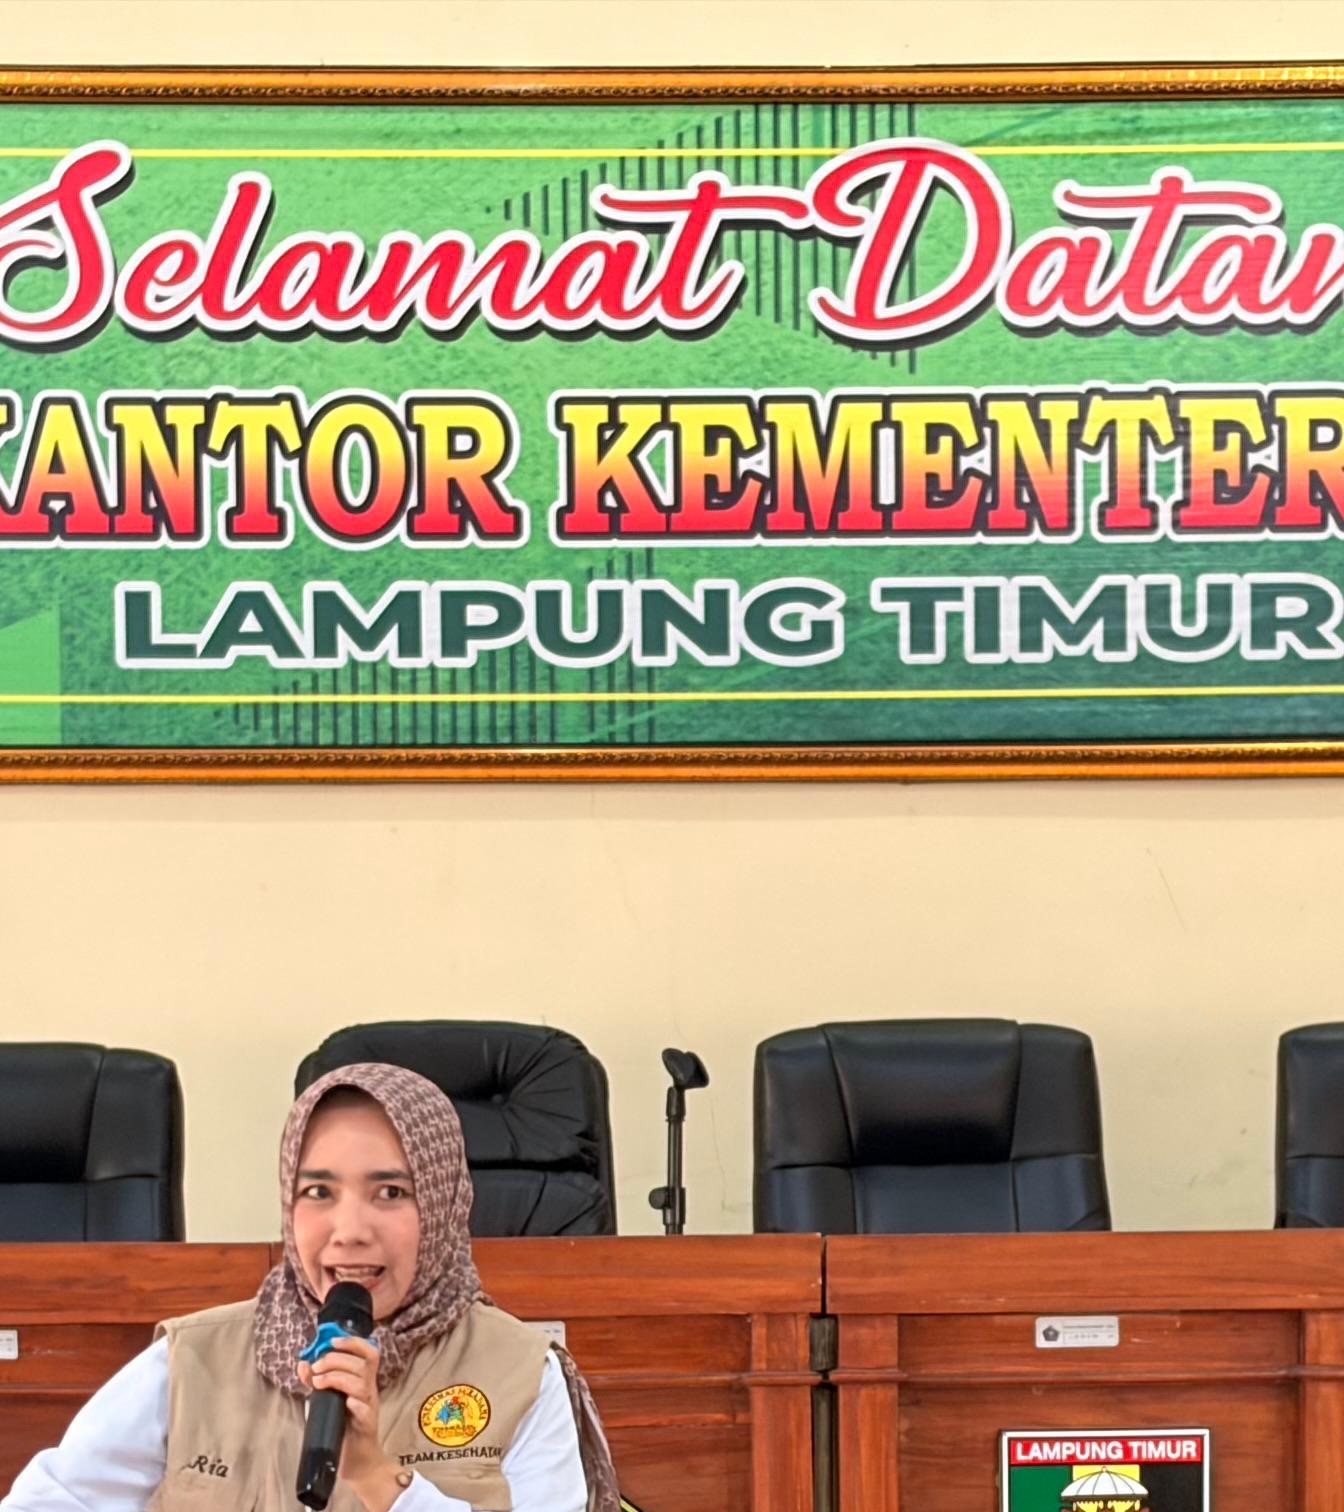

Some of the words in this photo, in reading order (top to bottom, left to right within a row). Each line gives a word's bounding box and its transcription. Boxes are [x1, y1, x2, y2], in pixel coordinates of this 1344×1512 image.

[115, 580, 844, 667] LAMPUNG
[398, 1452, 434, 1467] TEAM
[1015, 1441, 1124, 1461] LAMPUNG
[1128, 1440, 1197, 1459] TIMUR
[180, 1455, 229, 1478] Ria
